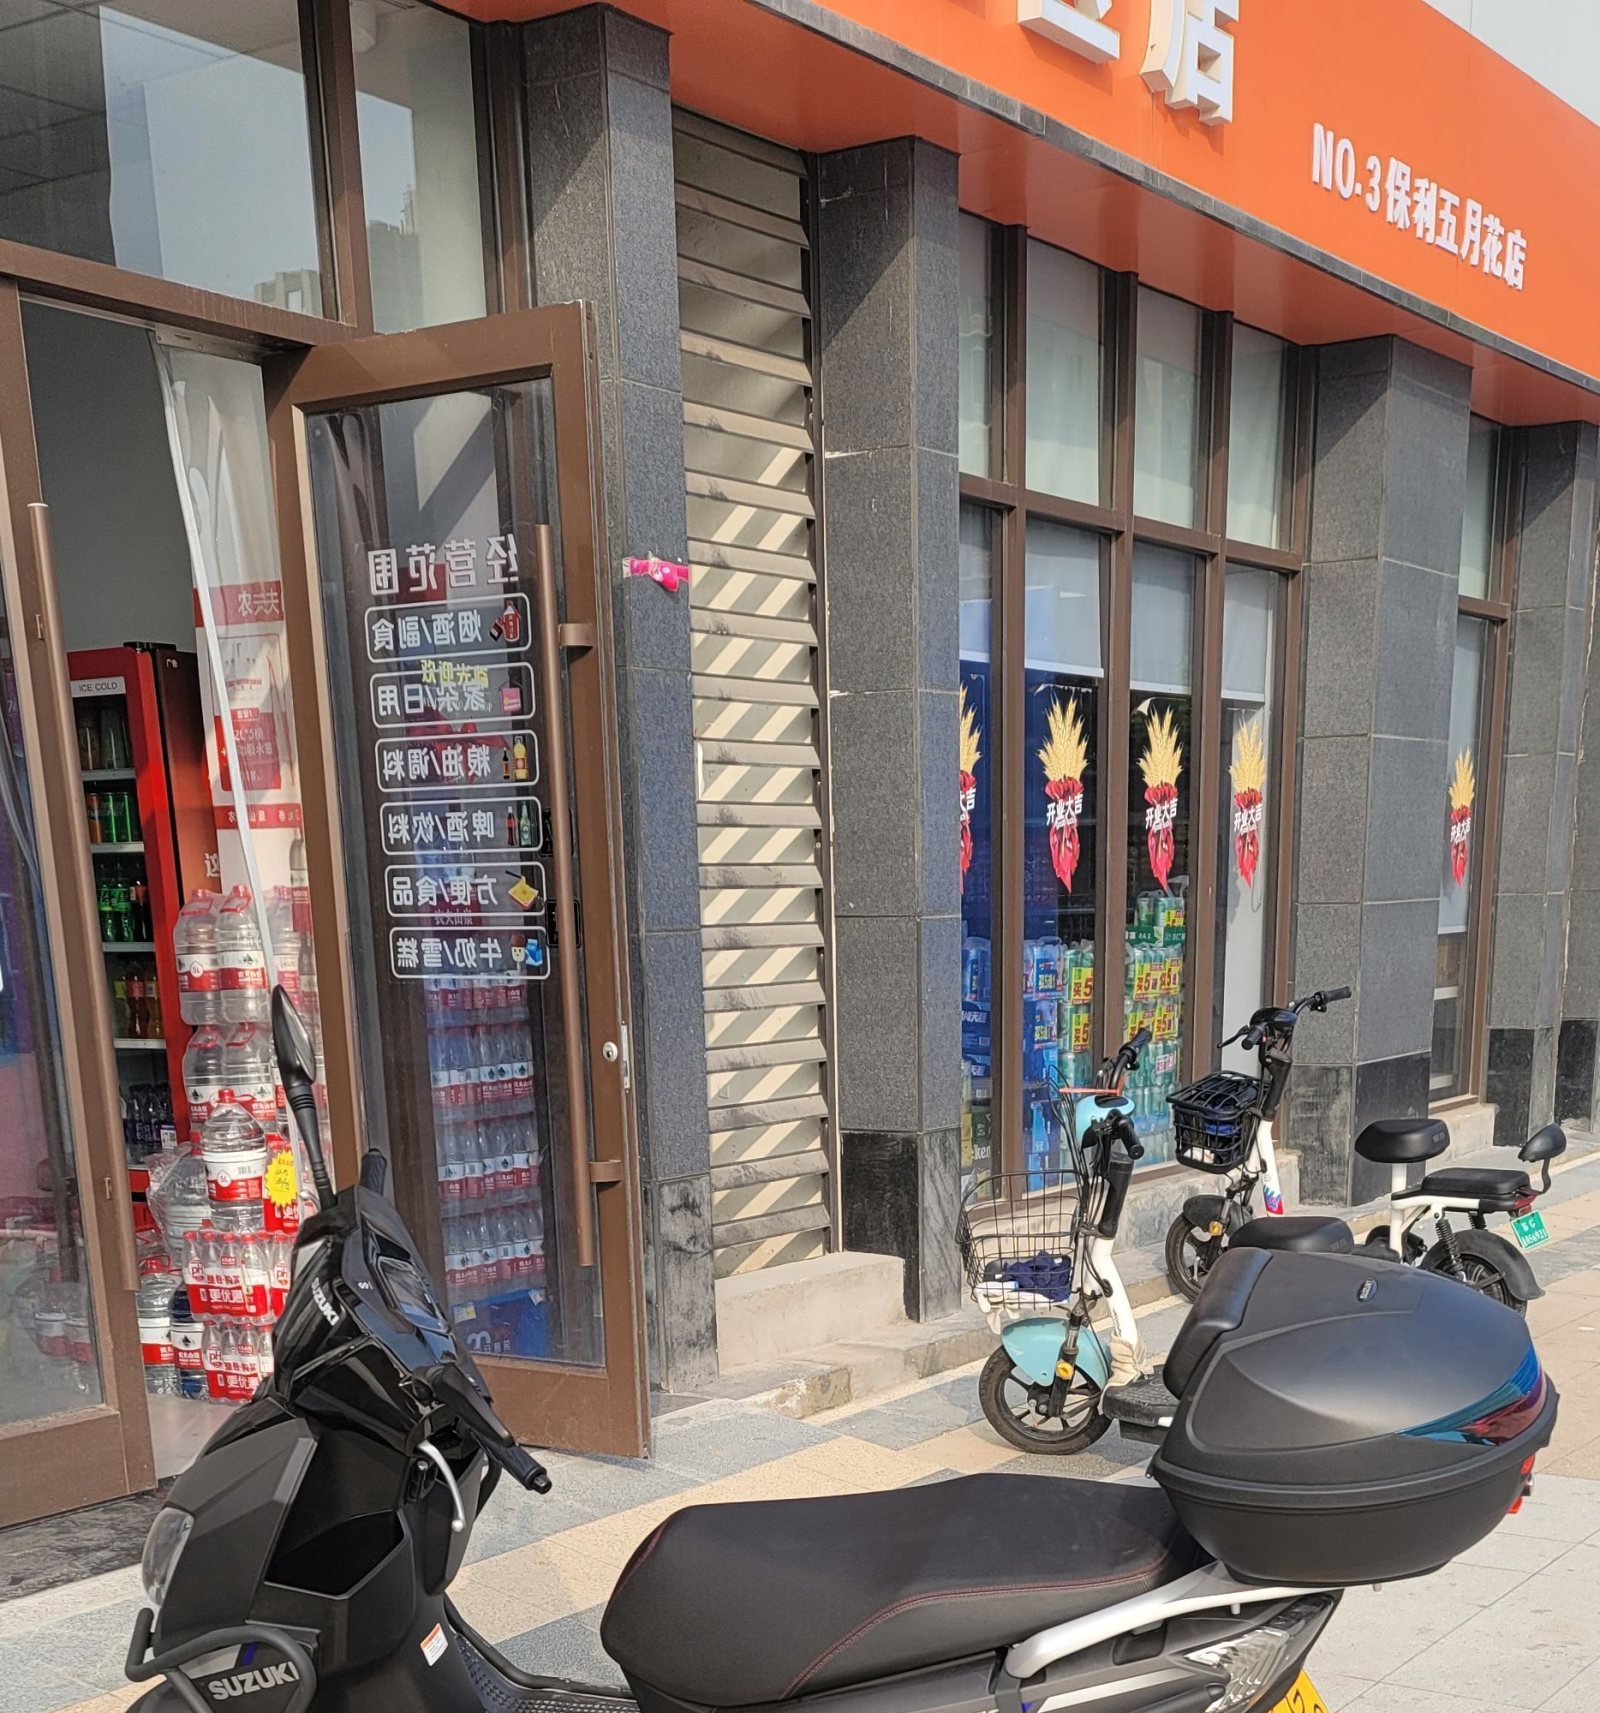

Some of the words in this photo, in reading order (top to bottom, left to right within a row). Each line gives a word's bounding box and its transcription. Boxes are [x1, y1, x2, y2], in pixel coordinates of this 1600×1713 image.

[79, 683, 93, 693] ICE
[95, 682, 118, 691] COLD
[311, 1277, 340, 1326] SUZUKI
[208, 1661, 300, 1700] SUZUKI
